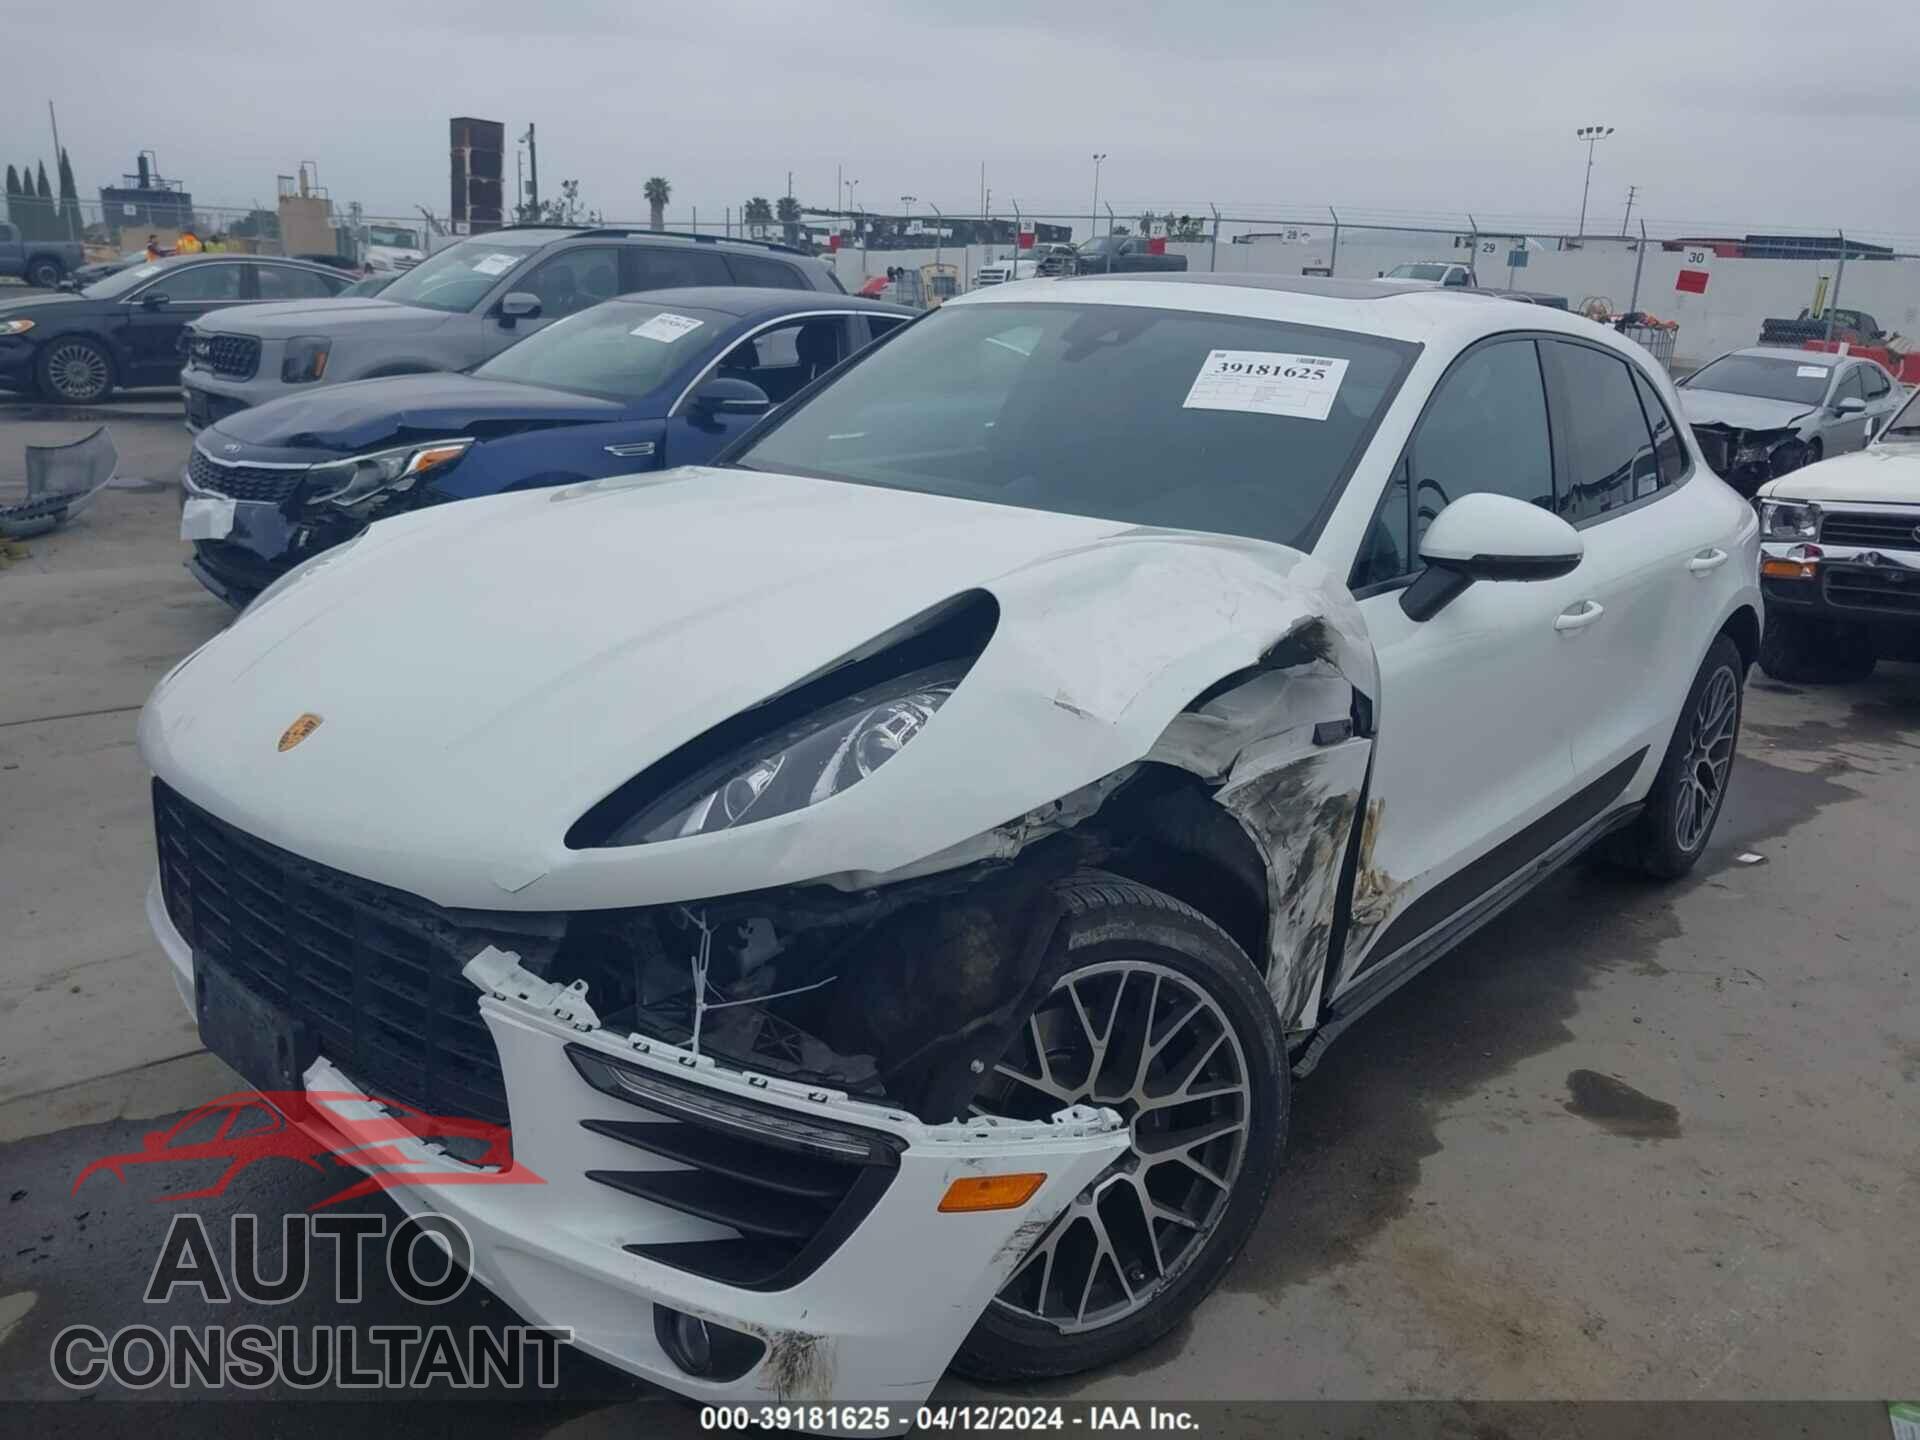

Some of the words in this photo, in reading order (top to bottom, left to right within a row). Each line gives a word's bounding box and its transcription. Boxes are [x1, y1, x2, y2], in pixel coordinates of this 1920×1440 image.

[1482, 242, 1496, 253] 29
[1688, 252, 1705, 264] 30
[1215, 362, 1326, 380] 39181625
